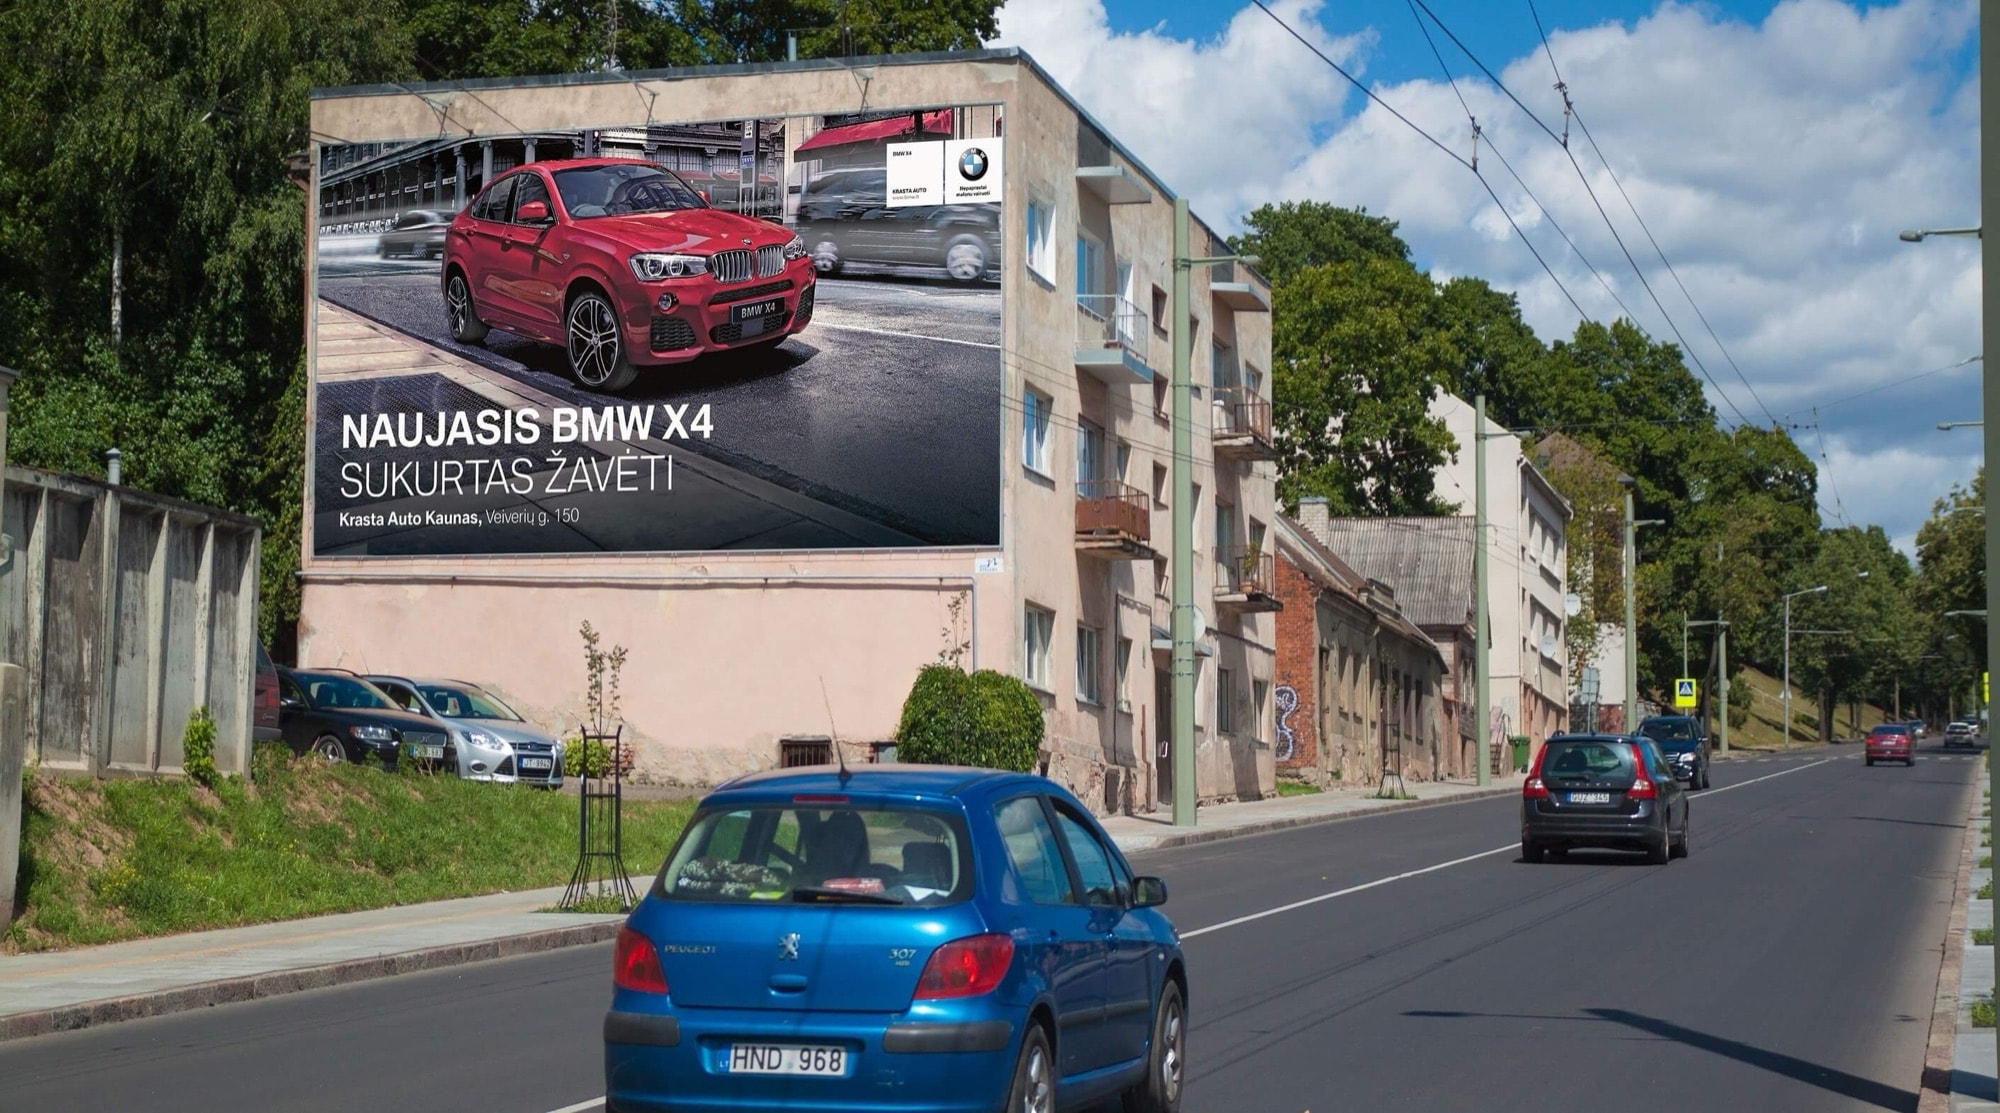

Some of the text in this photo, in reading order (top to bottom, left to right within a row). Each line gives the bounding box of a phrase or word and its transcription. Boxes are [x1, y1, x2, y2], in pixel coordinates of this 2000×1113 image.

[741, 302, 776, 318] BMW X4
[341, 403, 714, 448] NAUJASIS BMW X4
[340, 448, 674, 498] SUKURTAS ŽAVĖTI
[339, 507, 580, 527] Krasta Auto Kaunas, Veiverių g. 150
[664, 944, 717, 954] PEUGEOT
[888, 948, 917, 959] 307
[733, 1045, 841, 1072] HND 968
